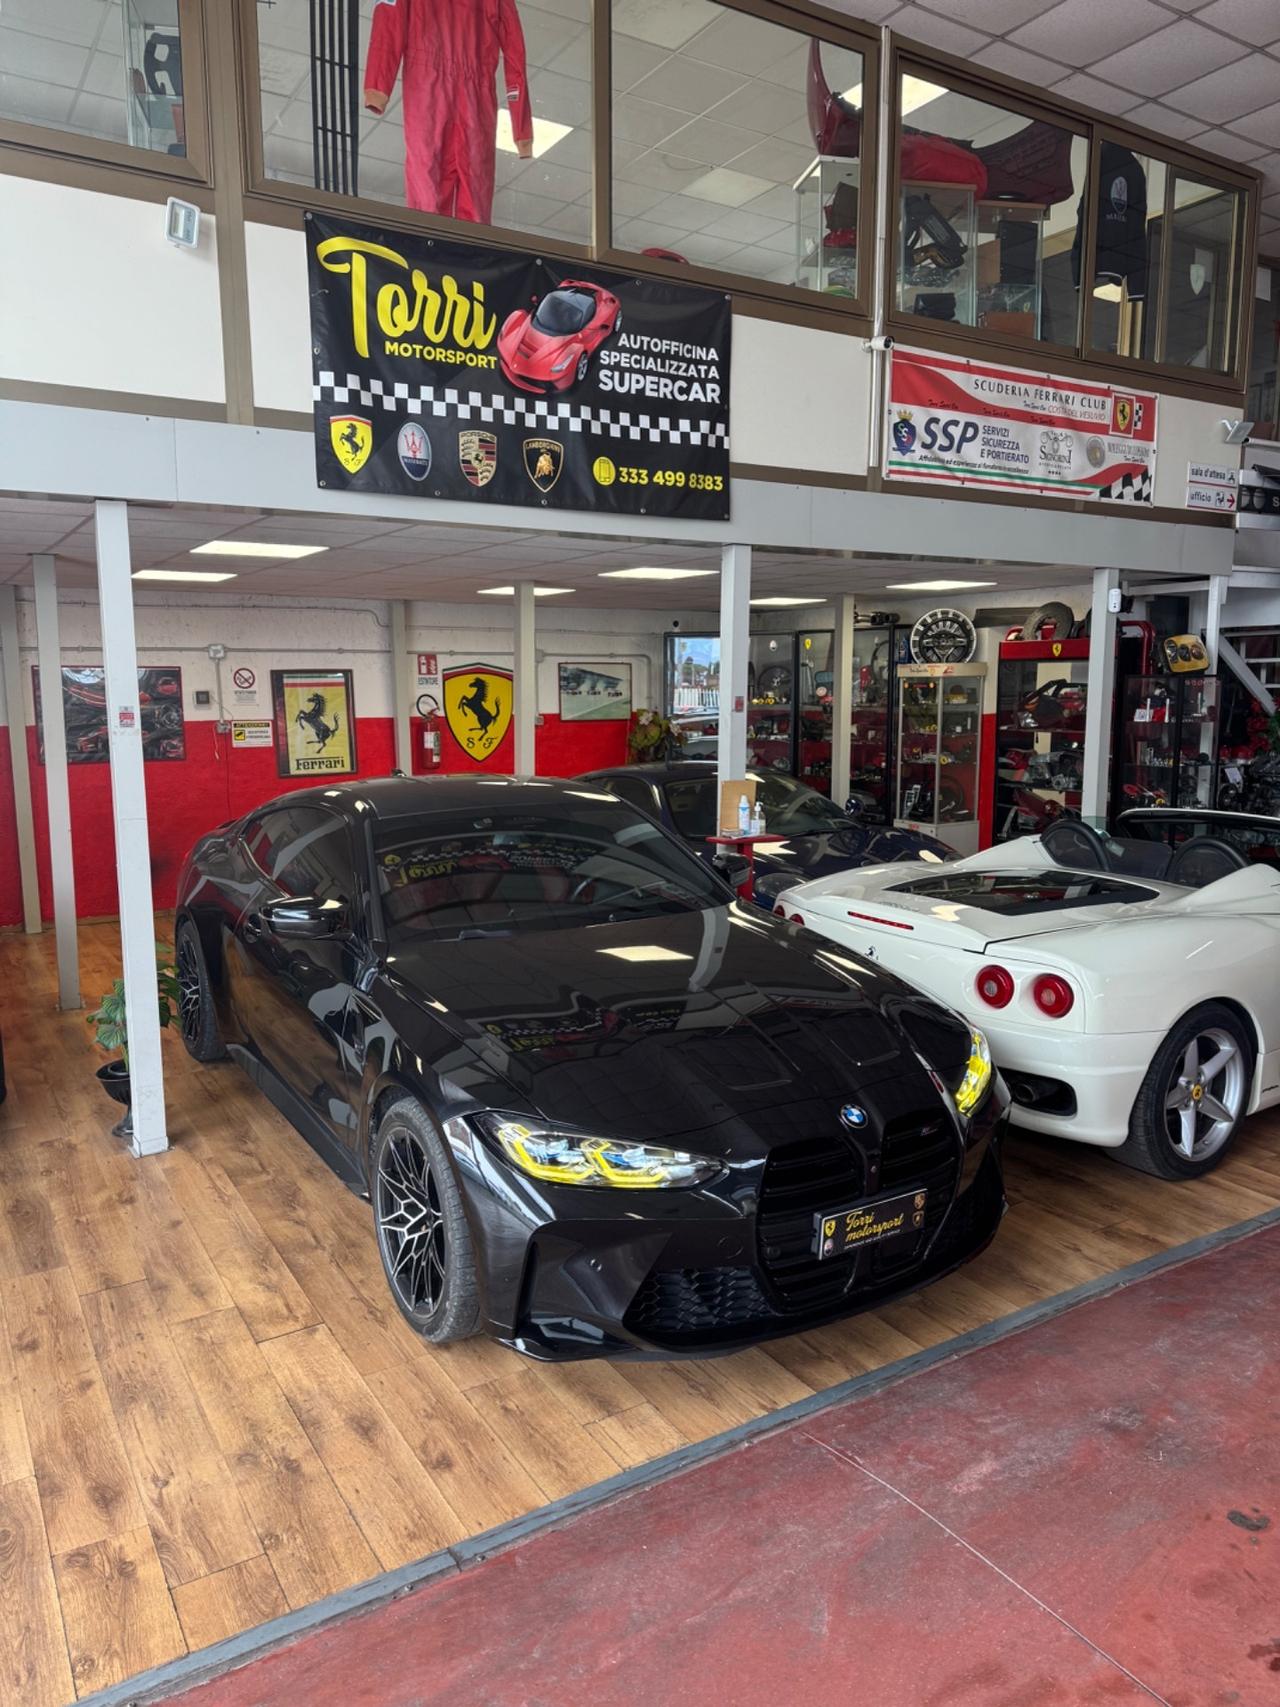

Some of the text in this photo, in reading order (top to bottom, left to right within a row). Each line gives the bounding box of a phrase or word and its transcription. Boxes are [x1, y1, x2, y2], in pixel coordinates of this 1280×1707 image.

[316, 236, 497, 358] Torri
[385, 341, 498, 369] MOTORSPORT
[618, 333, 719, 361] AUTOFFICINA
[599, 350, 720, 380] SPECIALIZZATA
[598, 369, 721, 404] SUPERCAR
[974, 379, 1030, 398] SCUDERIA
[1034, 388, 1075, 406] FERRARI
[1080, 397, 1107, 410] CLUB
[920, 416, 979, 454] SSP
[981, 437, 1020, 451] SICUREZZA
[982, 424, 1010, 438] SERVIZI
[980, 449, 1030, 464] E PORTIERATO
[619, 467, 724, 491] 333 499 8383
[466, 736, 476, 749] S
[295, 756, 346, 771] Ferrari
[845, 1212, 905, 1242] motorsport
[846, 1210, 876, 1231] Torri
